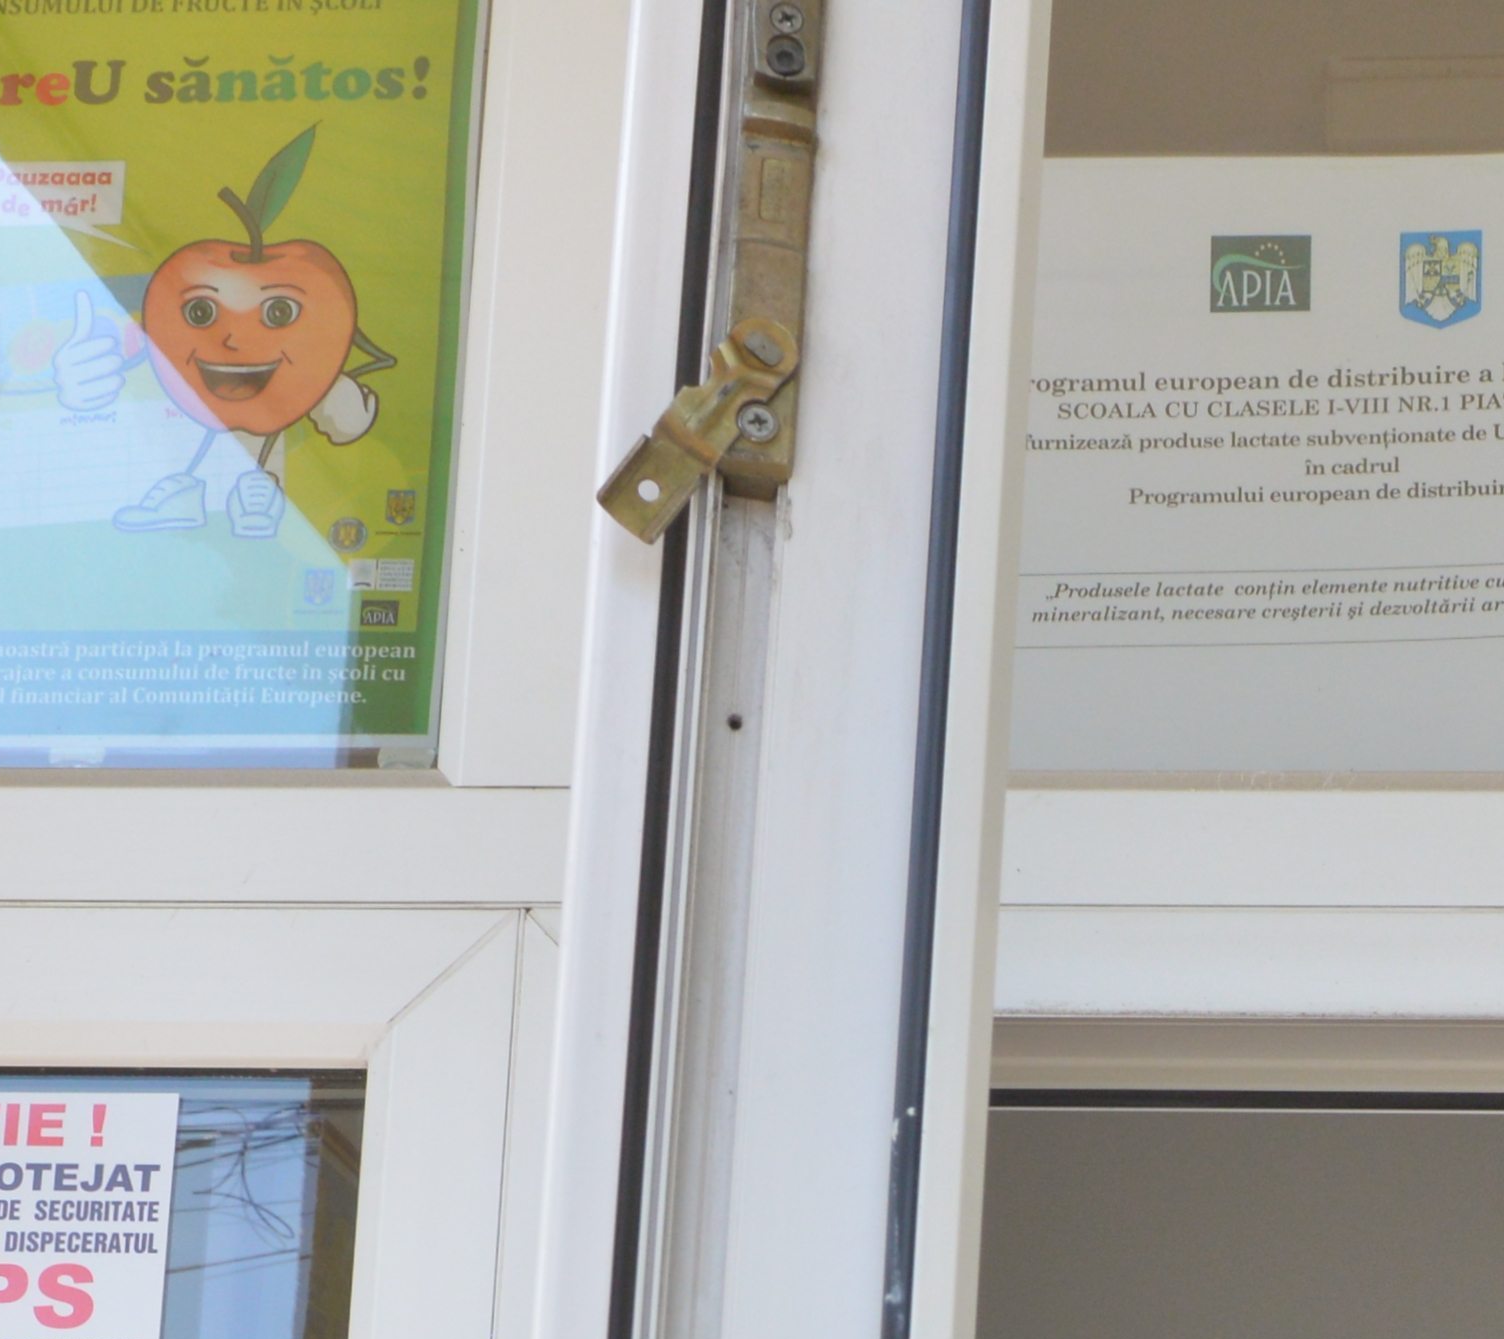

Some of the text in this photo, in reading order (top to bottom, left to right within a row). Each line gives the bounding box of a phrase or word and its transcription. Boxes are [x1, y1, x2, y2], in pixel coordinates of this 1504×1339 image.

[132, 0, 164, 13] DE
[171, 0, 269, 13] FRUCTE
[144, 54, 431, 104] sănătos!
[1, 195, 30, 216] de
[1217, 269, 1297, 307] APIA
[1154, 374, 1280, 395] european
[1288, 369, 1319, 389] de
[1327, 364, 1470, 390] distribuire
[1478, 367, 1494, 383] a
[1057, 401, 1157, 420] SCOALA
[1164, 401, 1199, 419] CU
[1207, 399, 1320, 418] CLASELE
[1326, 396, 1390, 417] I-VIII
[1397, 395, 1450, 413] NR.1
[1139, 432, 1225, 453] produse
[1230, 431, 1301, 449] lactate
[1461, 424, 1487, 441] de
[1304, 456, 1399, 476] în cadrul
[1129, 486, 1264, 509] Programului
[1270, 488, 1370, 507] european
[1376, 482, 1401, 499] de
[1155, 581, 1225, 598] lactate
[1301, 579, 1388, 596] elemente
[1393, 574, 1480, 592] nutritive
[363, 611, 395, 624] APIA
[1032, 606, 1165, 623] mineralizant,
[1171, 604, 1257, 620] necesare
[1369, 598, 1475, 617] dezvoltării
[75, 641, 168, 661] participă
[175, 641, 192, 657] la
[198, 641, 309, 661] programul
[315, 643, 416, 662] european
[61, 667, 72, 680] a
[77, 664, 199, 681] consumului
[204, 664, 229, 680] de
[235, 664, 296, 681] fructe
[301, 664, 323, 680] în
[381, 667, 406, 681] cu
[10, 688, 104, 705] financiar
[108, 688, 126, 704] al
[261, 688, 367, 706] Europene.
[90, 1103, 107, 1147] !
[34, 1200, 160, 1222] SECURITATE
[4, 1231, 159, 1254] DISPECERATUL
